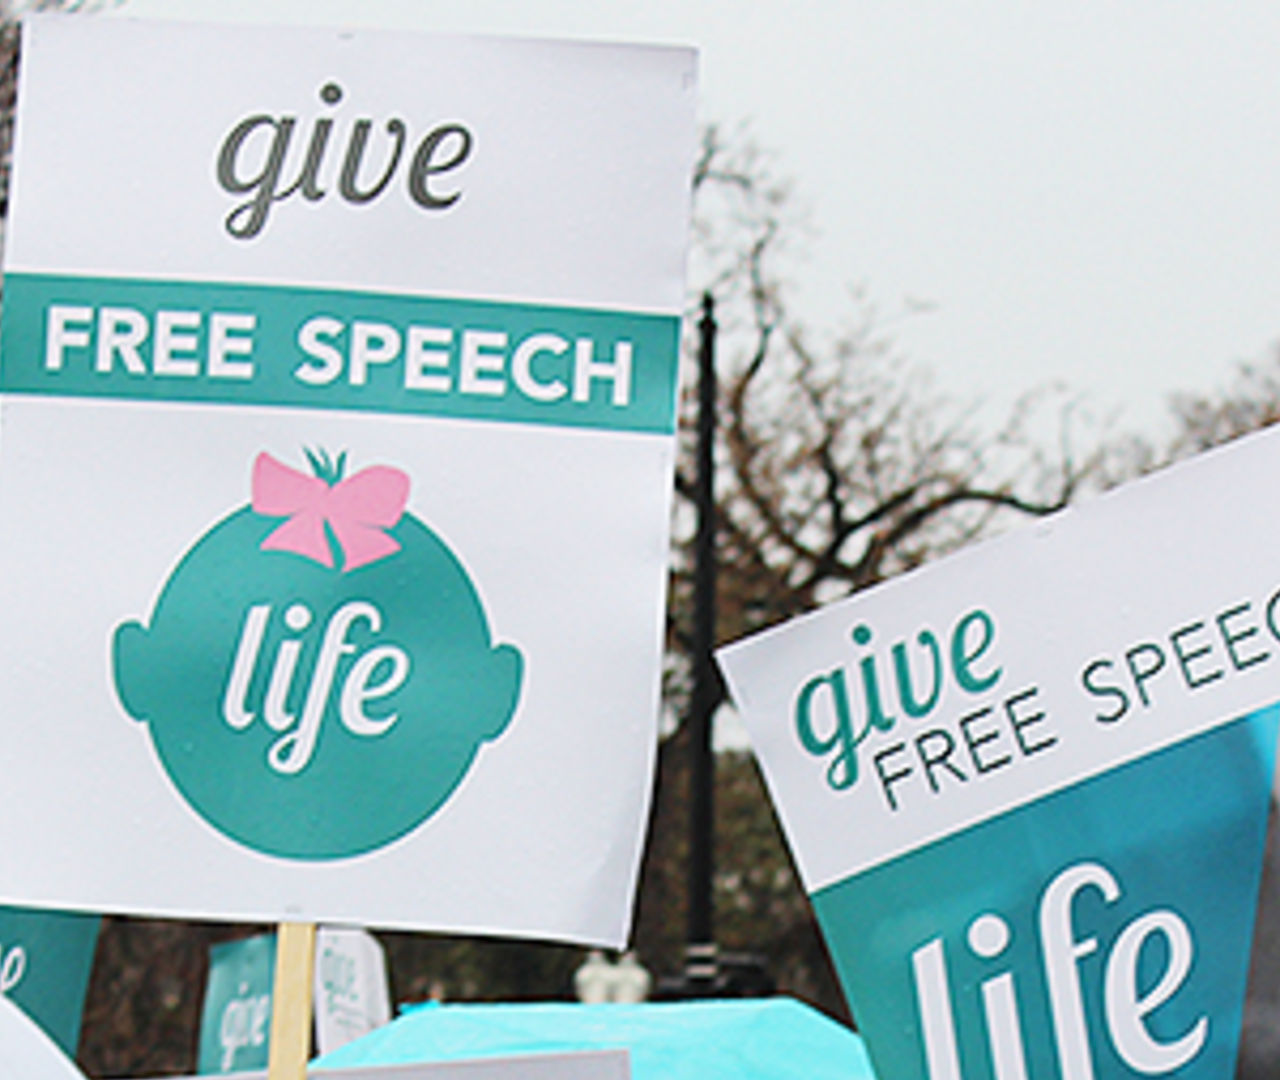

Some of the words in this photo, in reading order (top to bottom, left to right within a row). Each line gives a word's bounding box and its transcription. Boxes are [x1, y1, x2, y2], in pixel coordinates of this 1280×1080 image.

[216, 83, 473, 239] give
[44, 304, 257, 378] FREE
[294, 317, 633, 406] SPEECH
[222, 601, 409, 774] life
[793, 608, 1005, 792] give
[872, 687, 1058, 812] FREE
